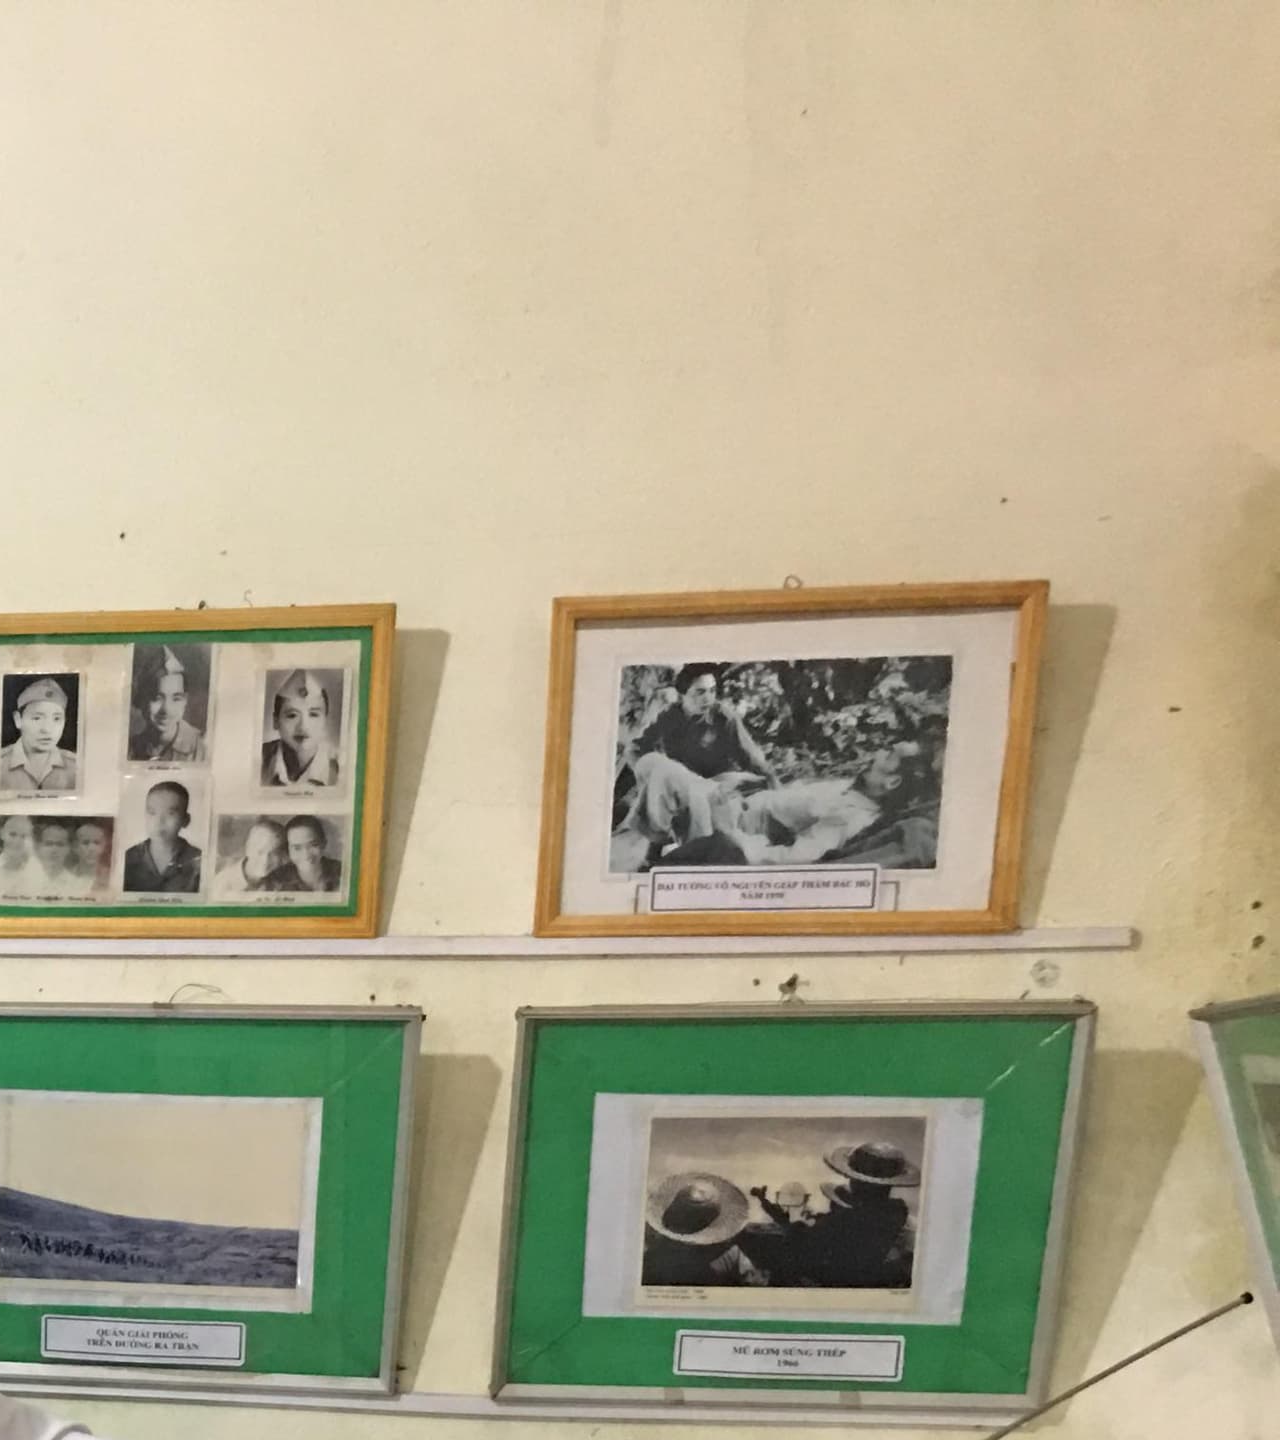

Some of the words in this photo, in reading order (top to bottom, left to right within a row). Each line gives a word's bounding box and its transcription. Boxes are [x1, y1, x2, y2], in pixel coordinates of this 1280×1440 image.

[95, 1327, 125, 1338] QUÂN
[753, 1347, 780, 1356] RƠM
[782, 1346, 813, 1357] SÚNG
[816, 1346, 846, 1358] THÉP
